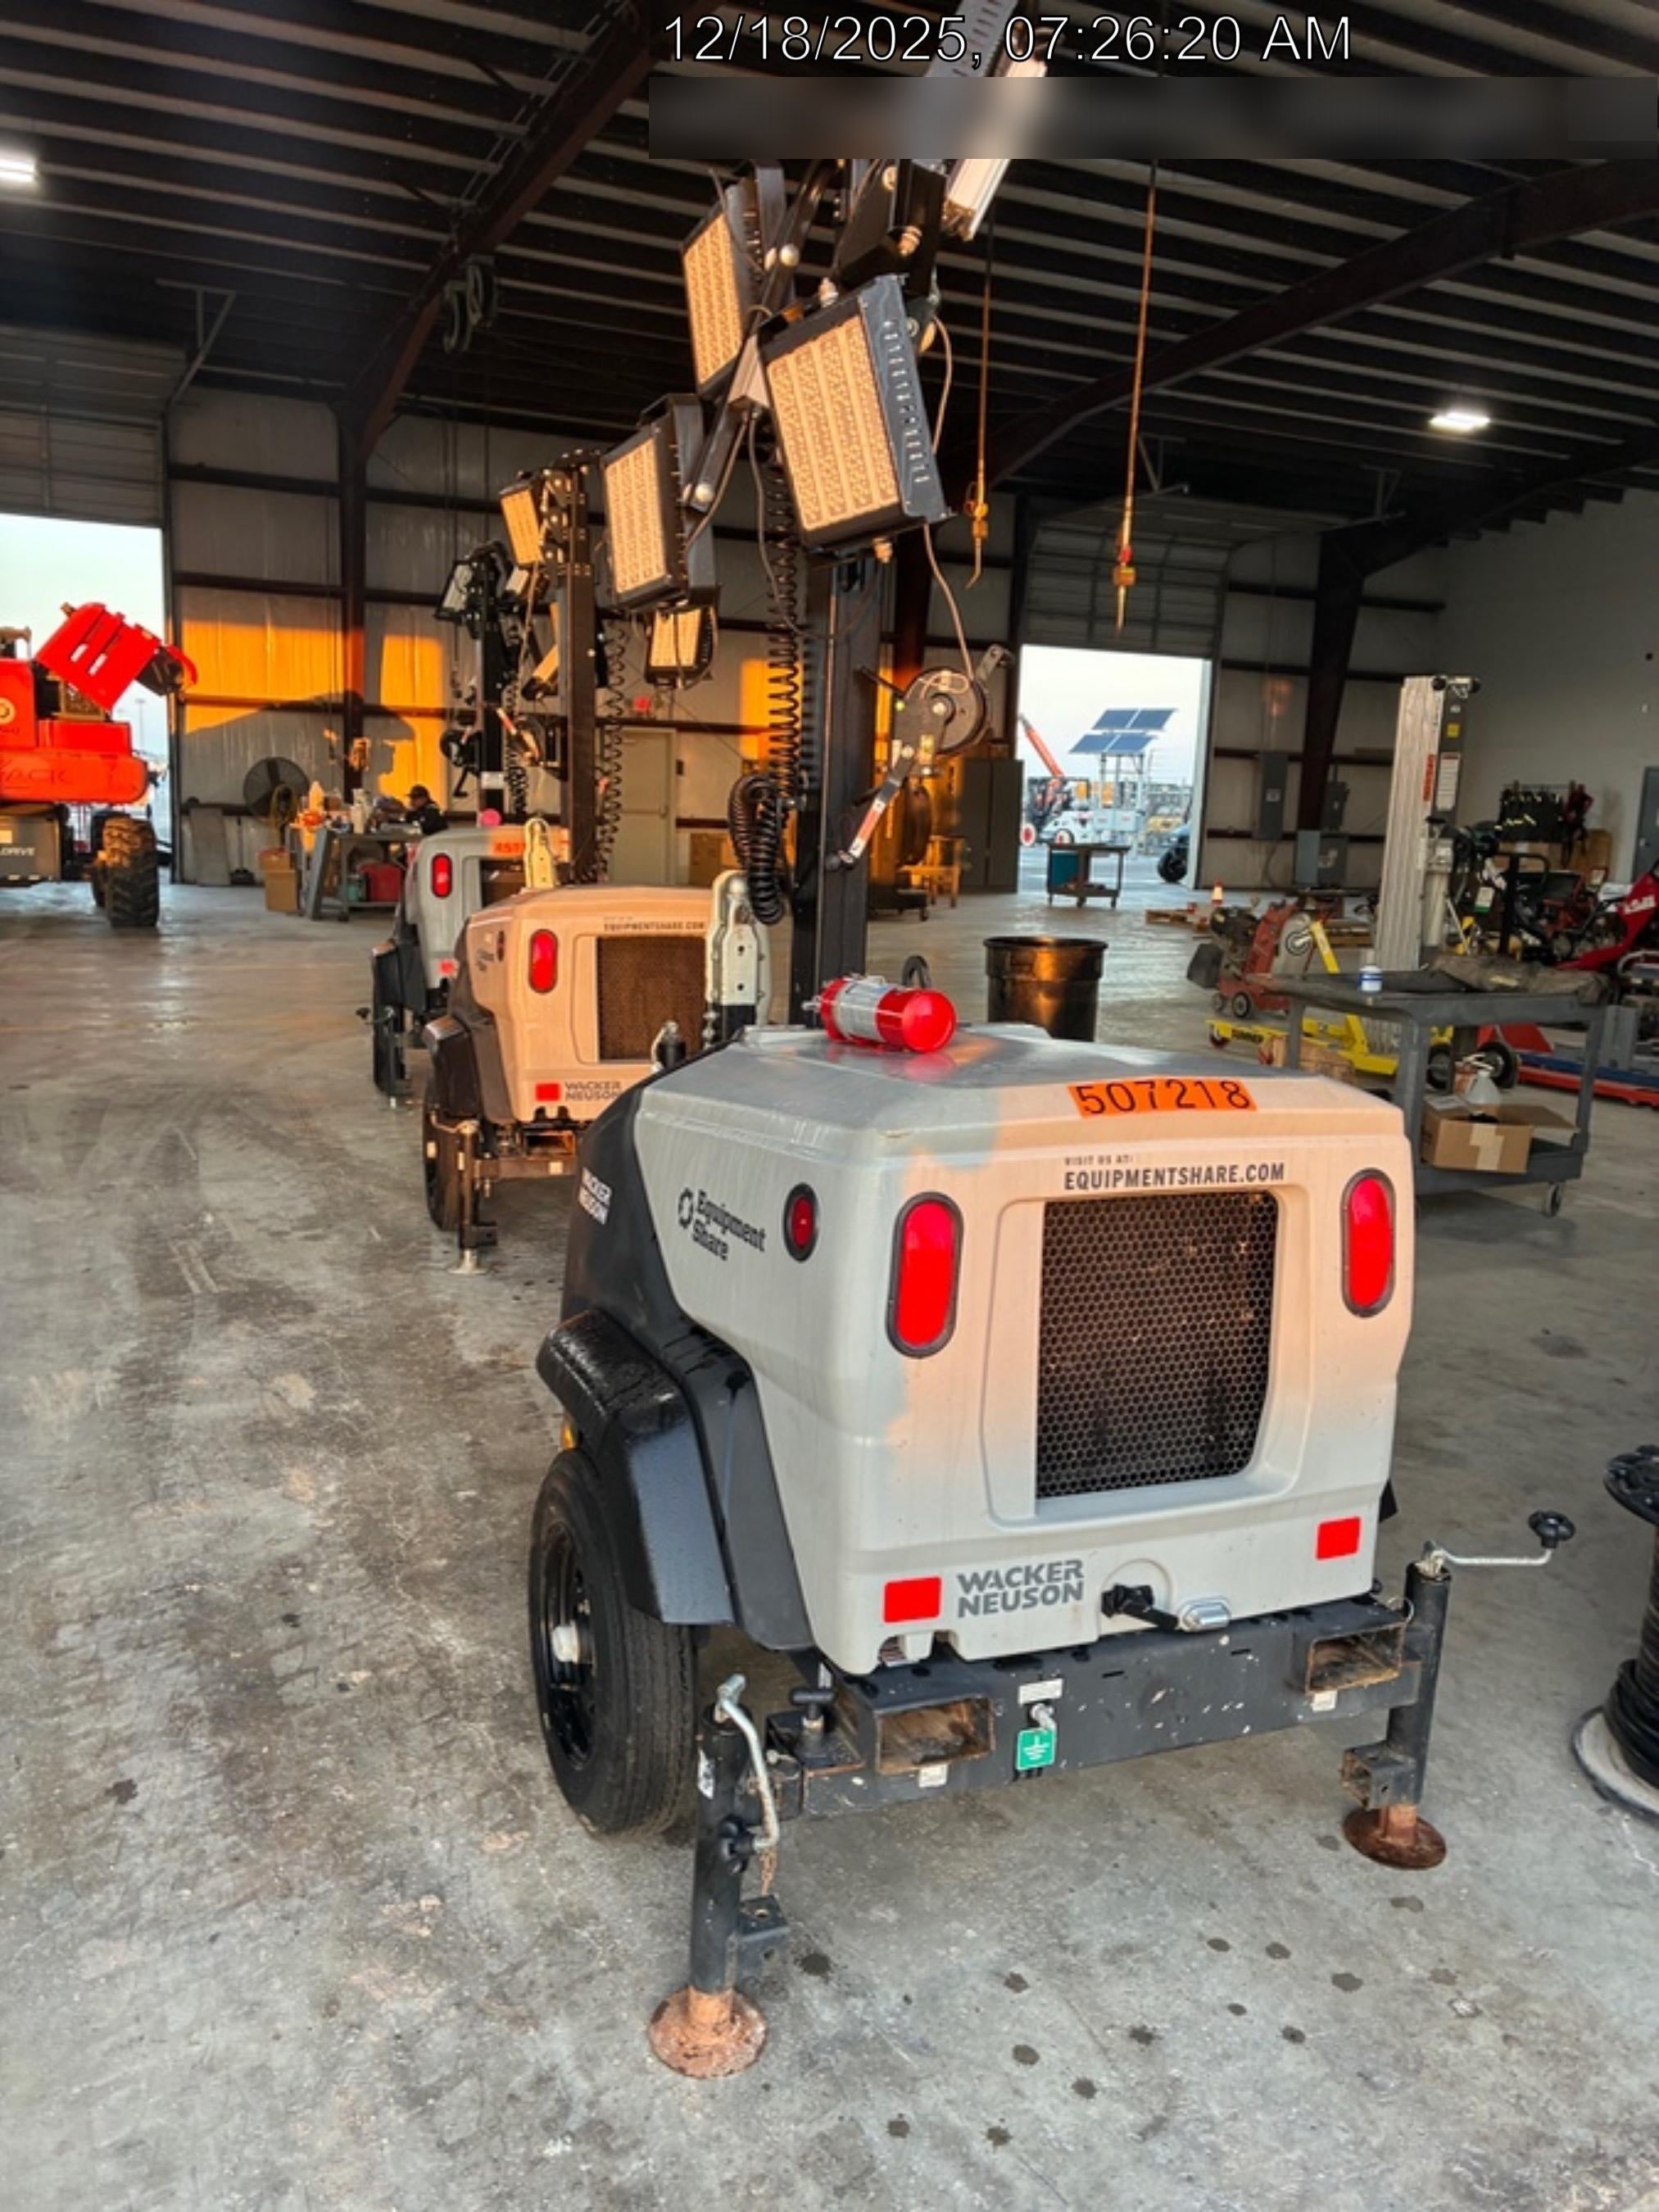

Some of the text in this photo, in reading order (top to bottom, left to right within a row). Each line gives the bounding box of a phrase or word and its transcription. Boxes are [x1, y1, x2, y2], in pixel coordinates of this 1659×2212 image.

[1076, 1079, 1251, 1114] 507218
[1064, 1163, 1285, 1190] EQUIPMENTSHARE.COM
[697, 1190, 766, 1252] Equipment
[692, 1218, 729, 1262] Share
[957, 1559, 1085, 1594] WACKER
[958, 1581, 1084, 1618] NEUSON
